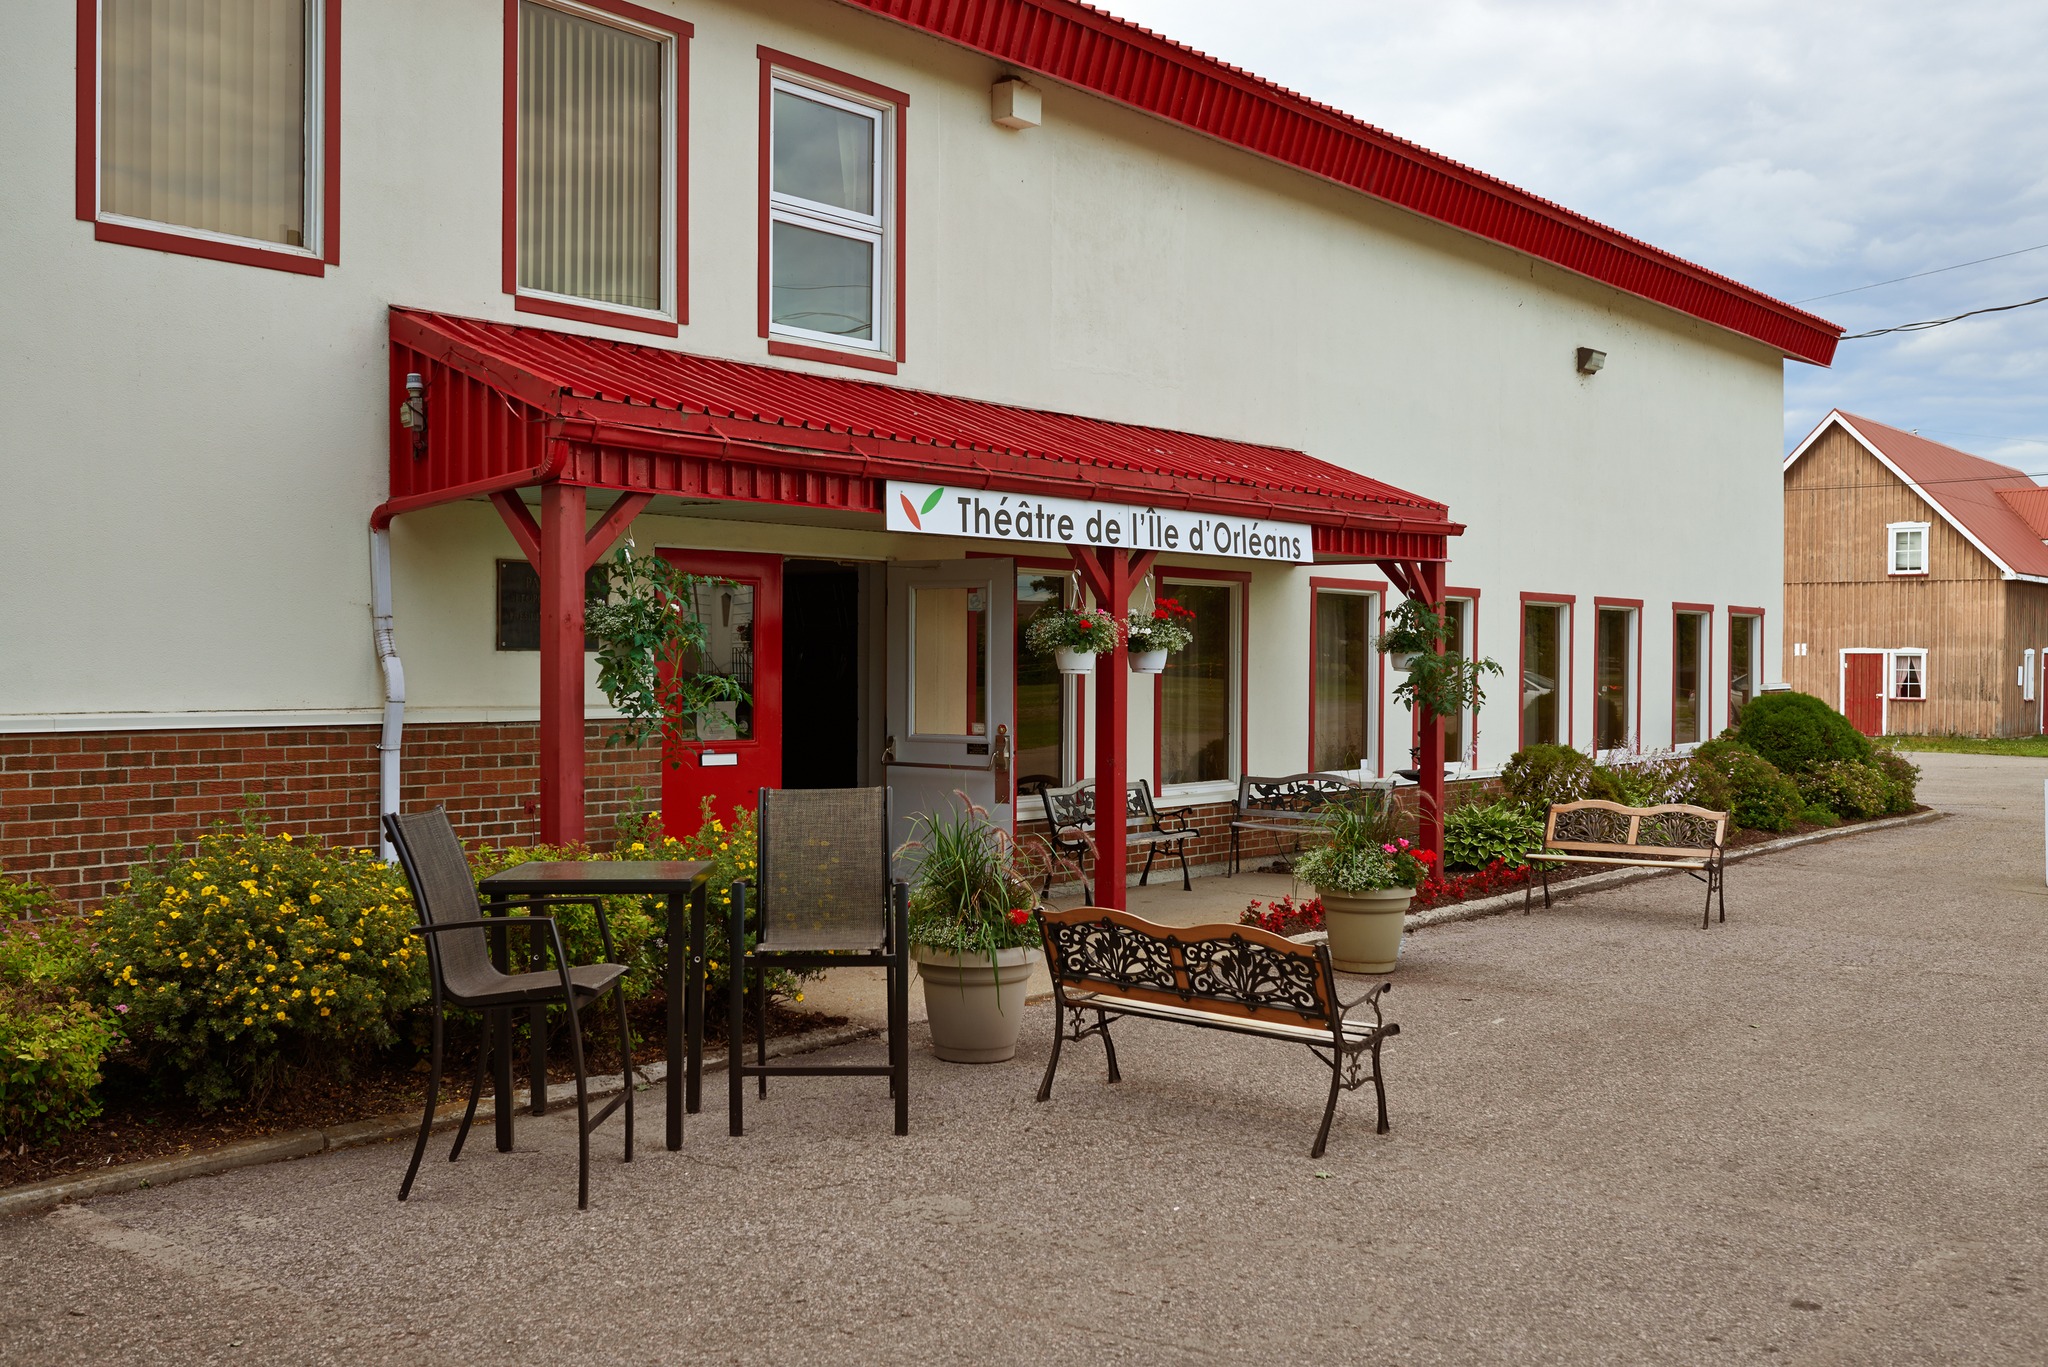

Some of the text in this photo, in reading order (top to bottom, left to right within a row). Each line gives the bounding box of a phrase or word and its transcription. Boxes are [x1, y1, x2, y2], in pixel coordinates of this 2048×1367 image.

[957, 496, 1074, 541] Théâtre
[1086, 509, 1121, 545] de
[1189, 519, 1301, 560] d'Orléans
